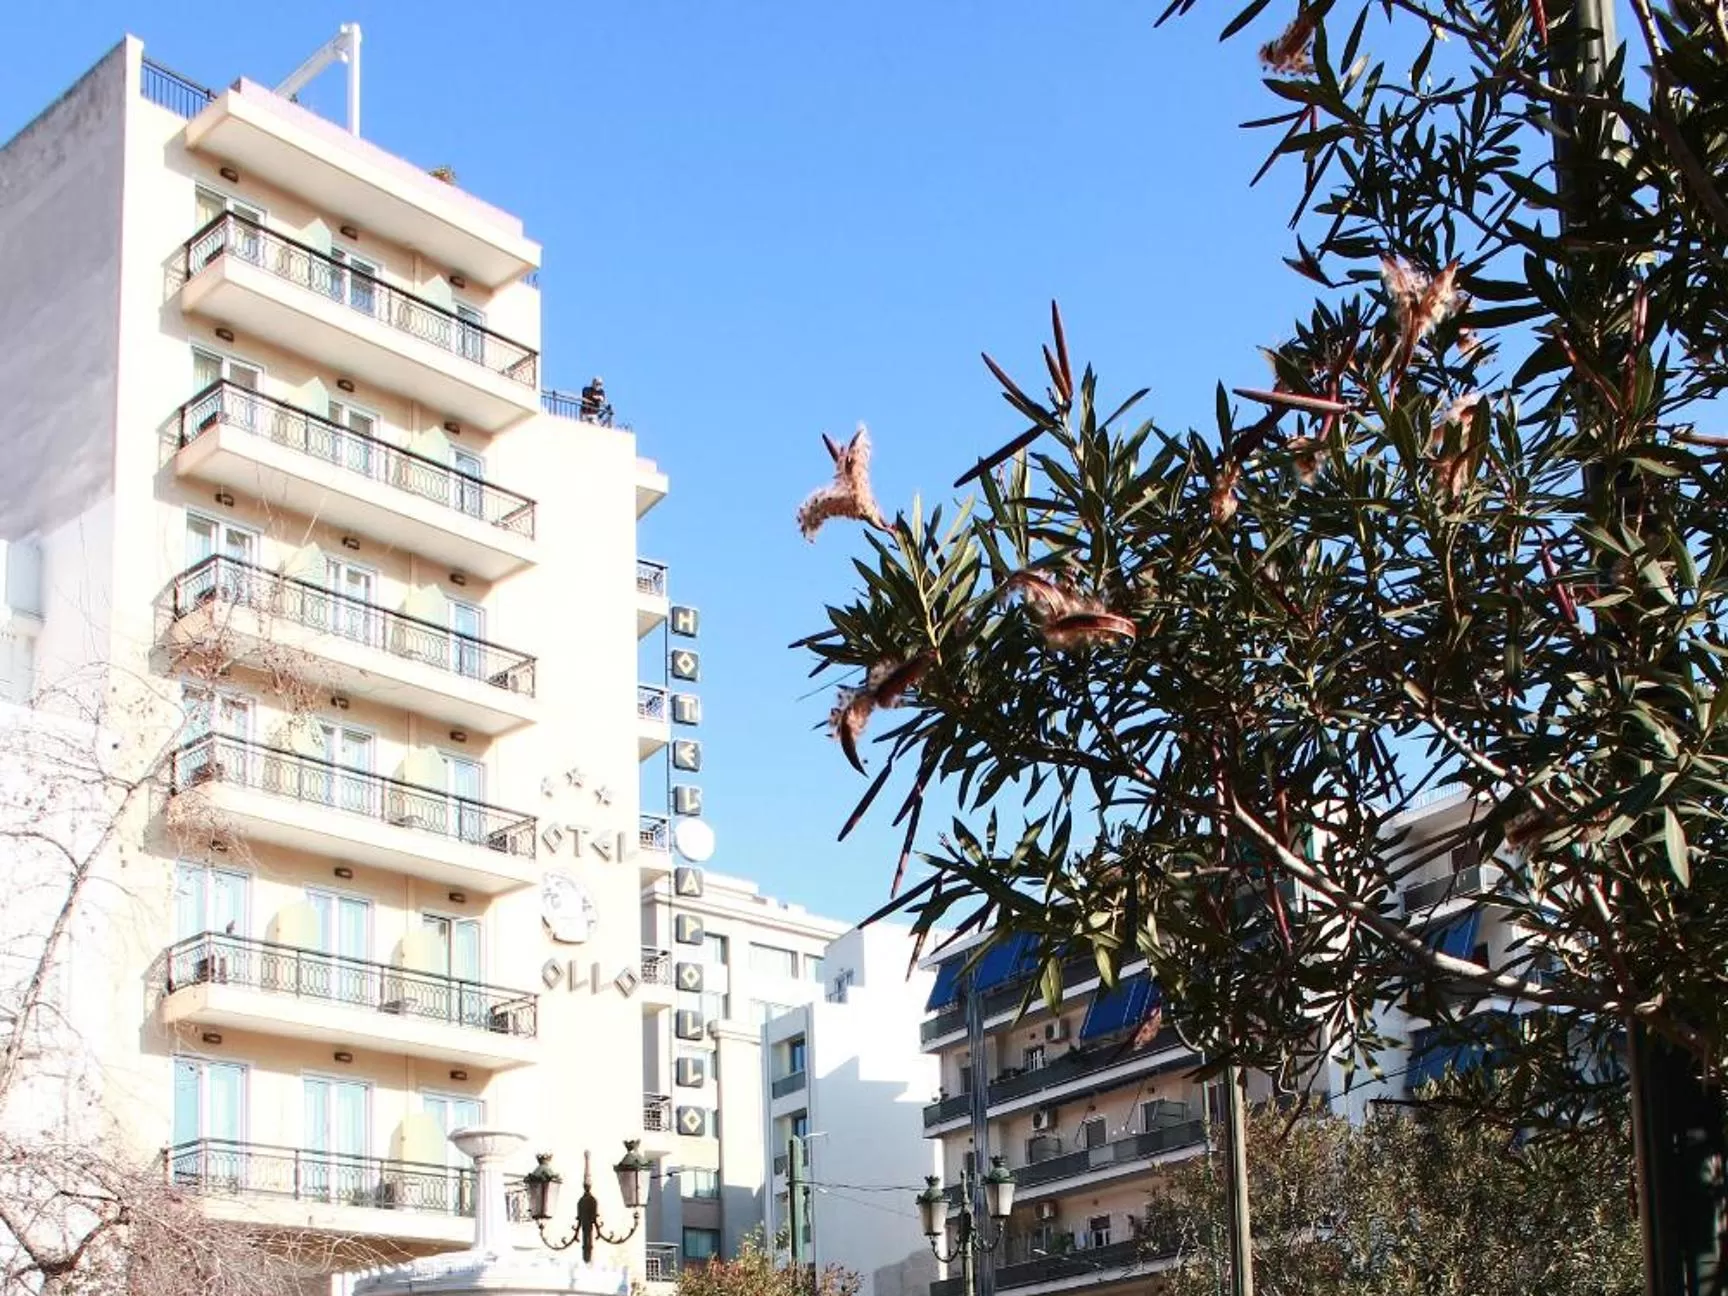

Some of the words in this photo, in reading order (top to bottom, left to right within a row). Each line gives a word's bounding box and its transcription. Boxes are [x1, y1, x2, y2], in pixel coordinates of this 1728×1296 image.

[674, 608, 700, 818] HOTEL
[540, 820, 638, 865] OTEL
[540, 956, 642, 1000] OLLO
[678, 869, 703, 1135] APOLLO
